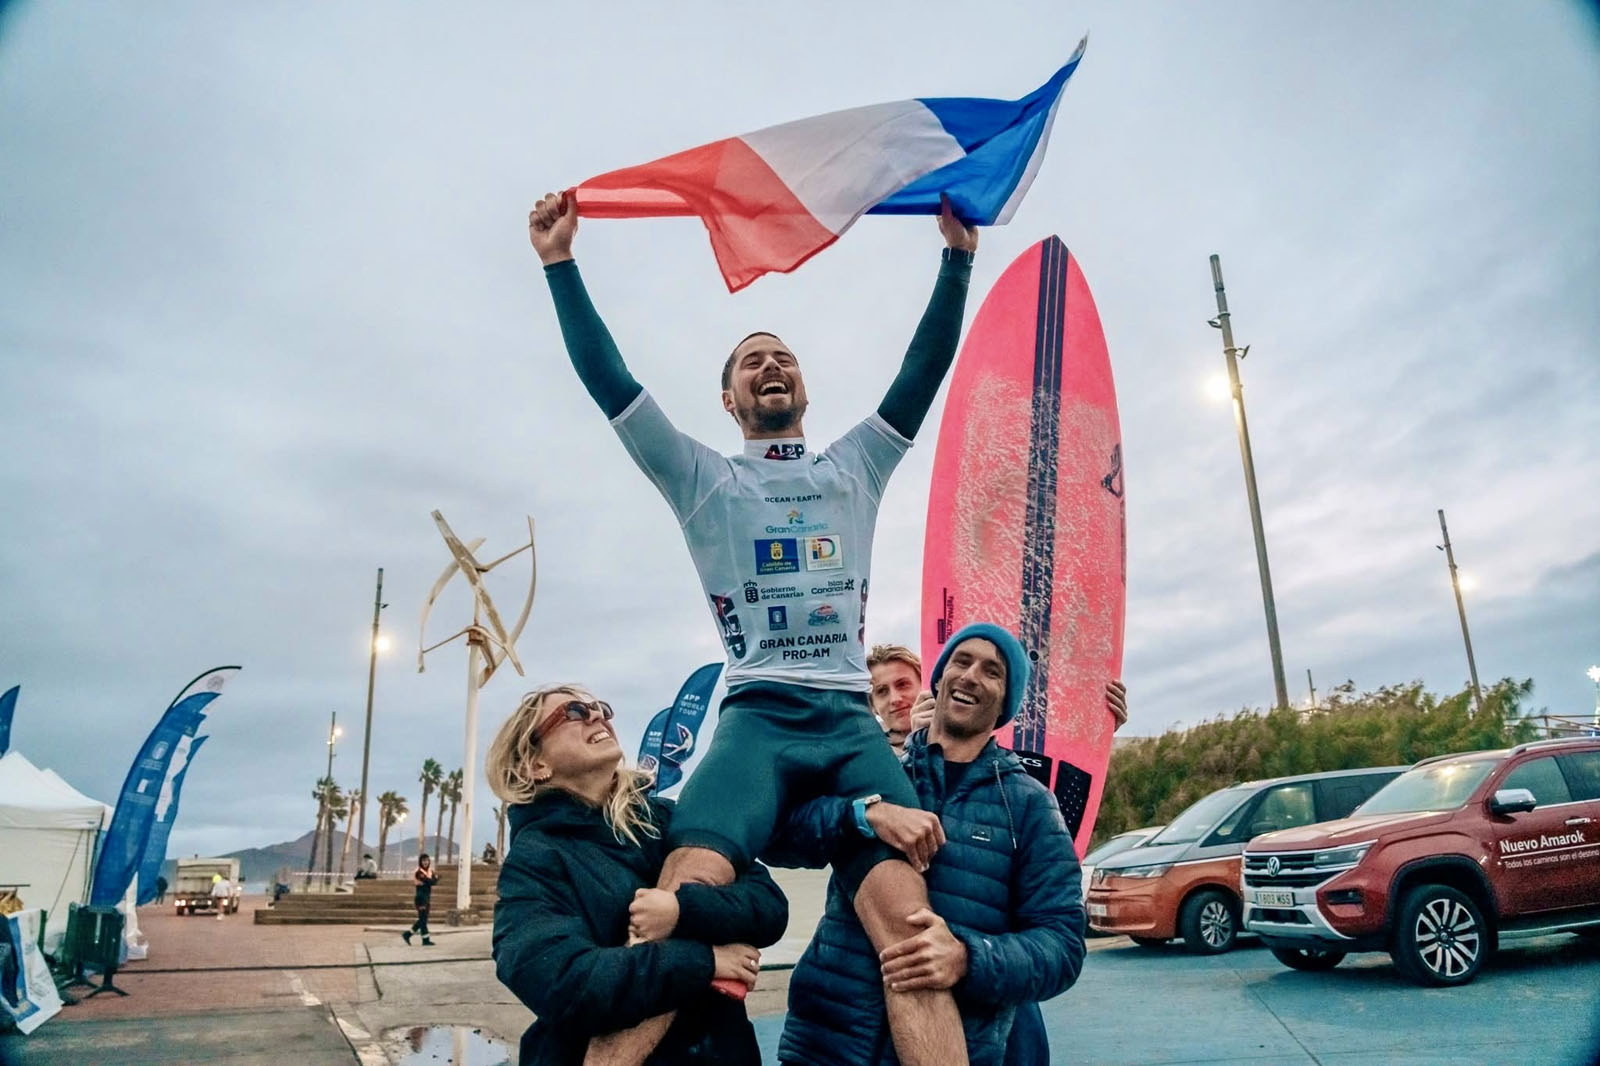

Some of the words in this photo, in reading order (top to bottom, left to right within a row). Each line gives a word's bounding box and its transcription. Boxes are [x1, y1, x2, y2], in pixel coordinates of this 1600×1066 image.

[797, 494, 822, 502] EARTH
[760, 586, 796, 595] Gobierno
[761, 592, 770, 600] de
[771, 590, 805, 599] Canarias
[811, 586, 844, 595] Canarias
[759, 637, 795, 650] GRAN
[797, 633, 848, 647] CANARIA
[783, 648, 830, 660] PRO-AM
[683, 693, 700, 701] APP
[680, 701, 705, 710] WORLD
[679, 707, 697, 715] TOUR
[1499, 839, 1538, 853] Nuevo
[1540, 830, 1585, 848] Amarok
[1504, 860, 1522, 869] Todos
[1523, 858, 1533, 866] los
[1533, 855, 1558, 865] caminos
[1559, 853, 1571, 861] son
[1572, 851, 1577, 860] el
[1578, 849, 1599, 858] destino
